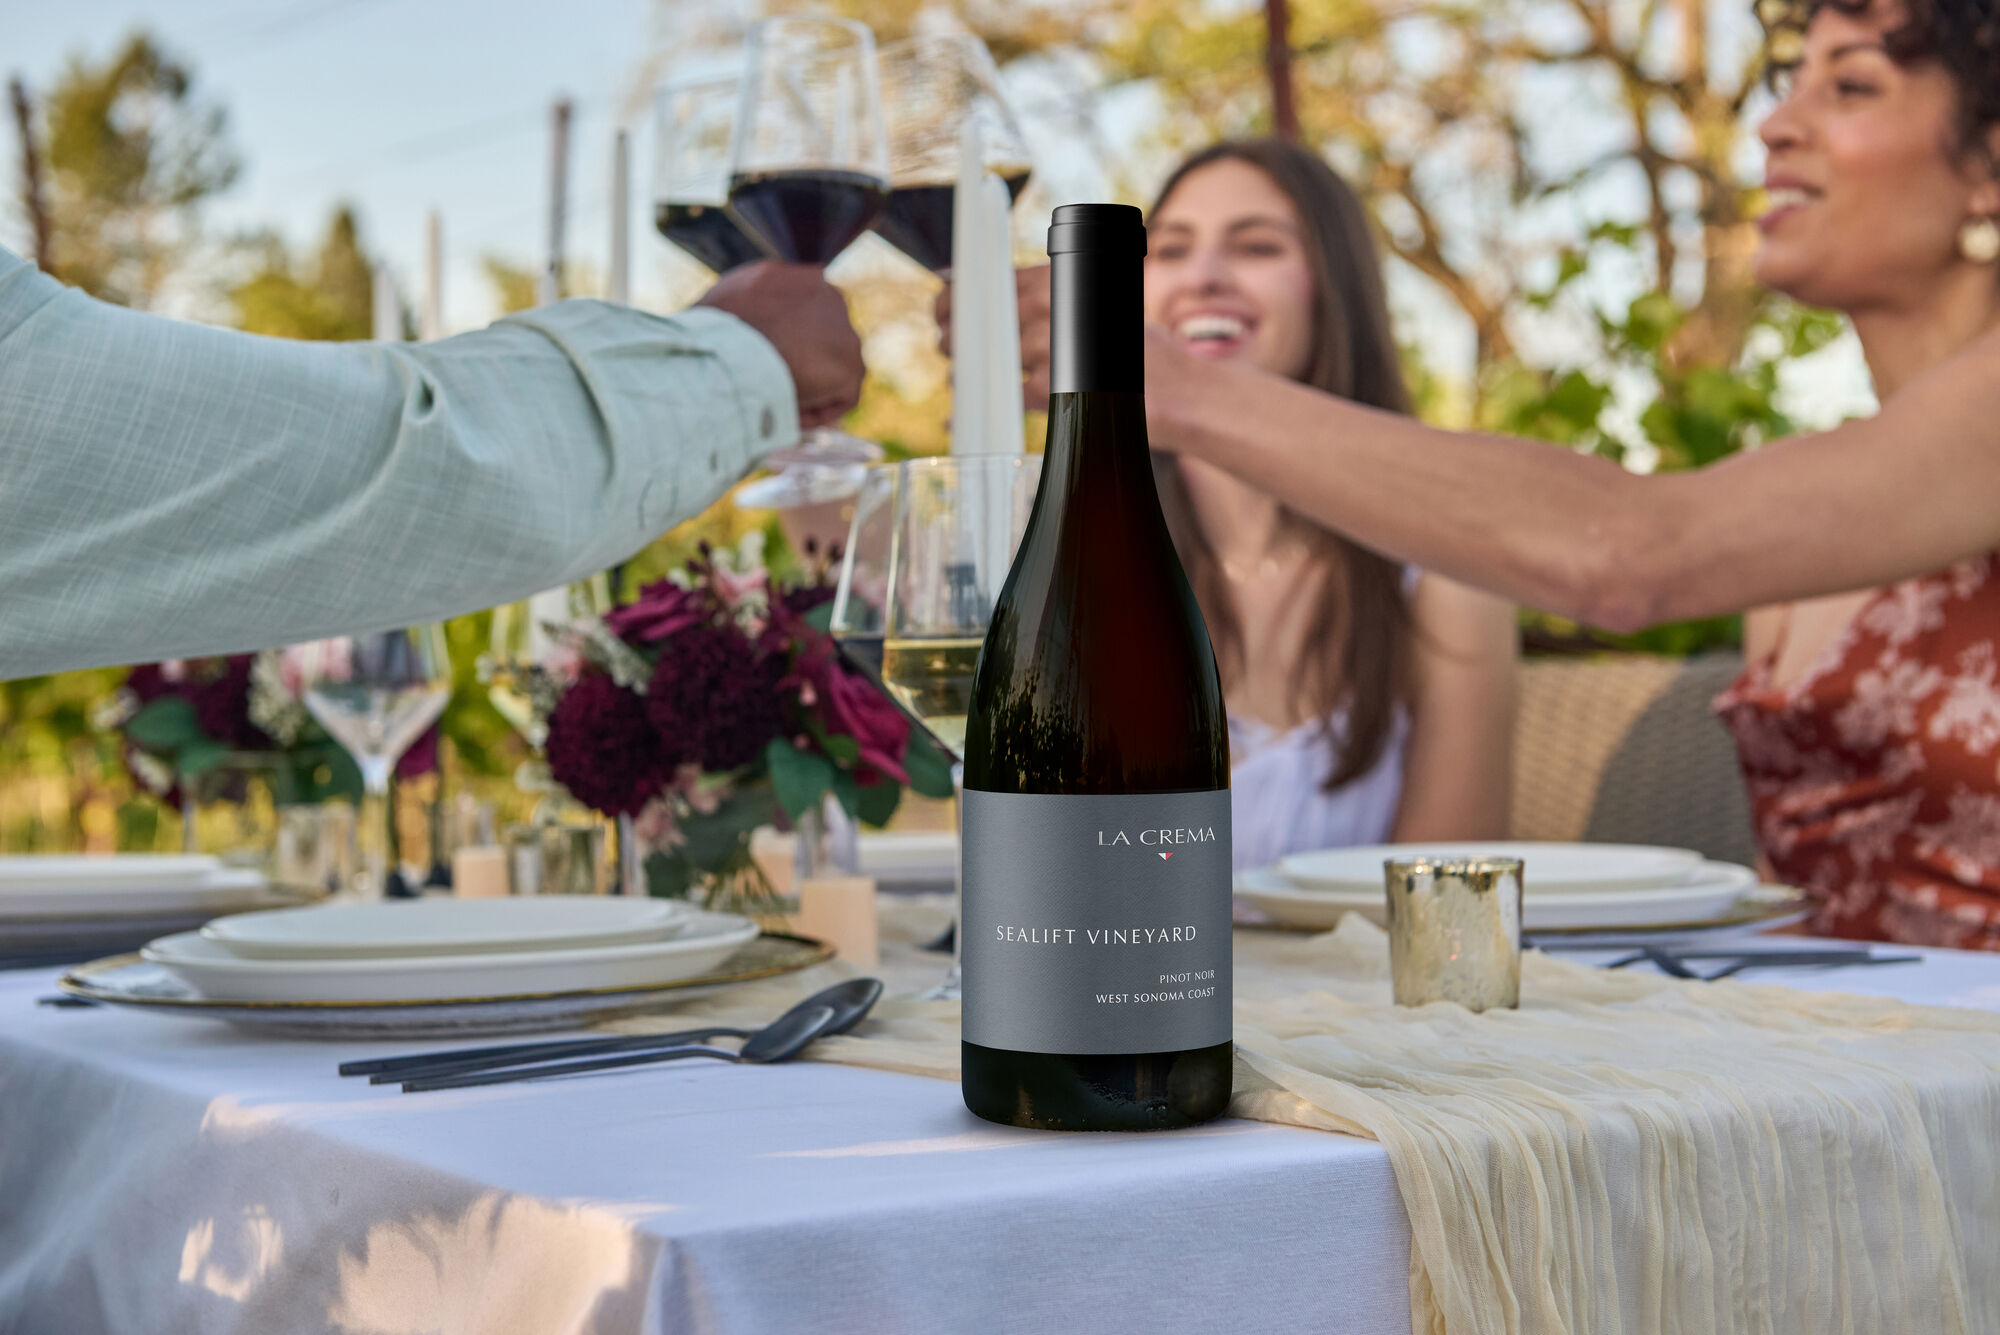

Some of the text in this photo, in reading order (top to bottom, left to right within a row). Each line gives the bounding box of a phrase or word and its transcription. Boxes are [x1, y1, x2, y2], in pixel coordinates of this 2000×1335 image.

[1098, 827, 1216, 846] LA CREMA
[996, 925, 1197, 945] SEALIFT VINEYARD
[1160, 969, 1215, 984] PINOT NOIR
[1096, 986, 1215, 1004] WEST SONOMA COAST
